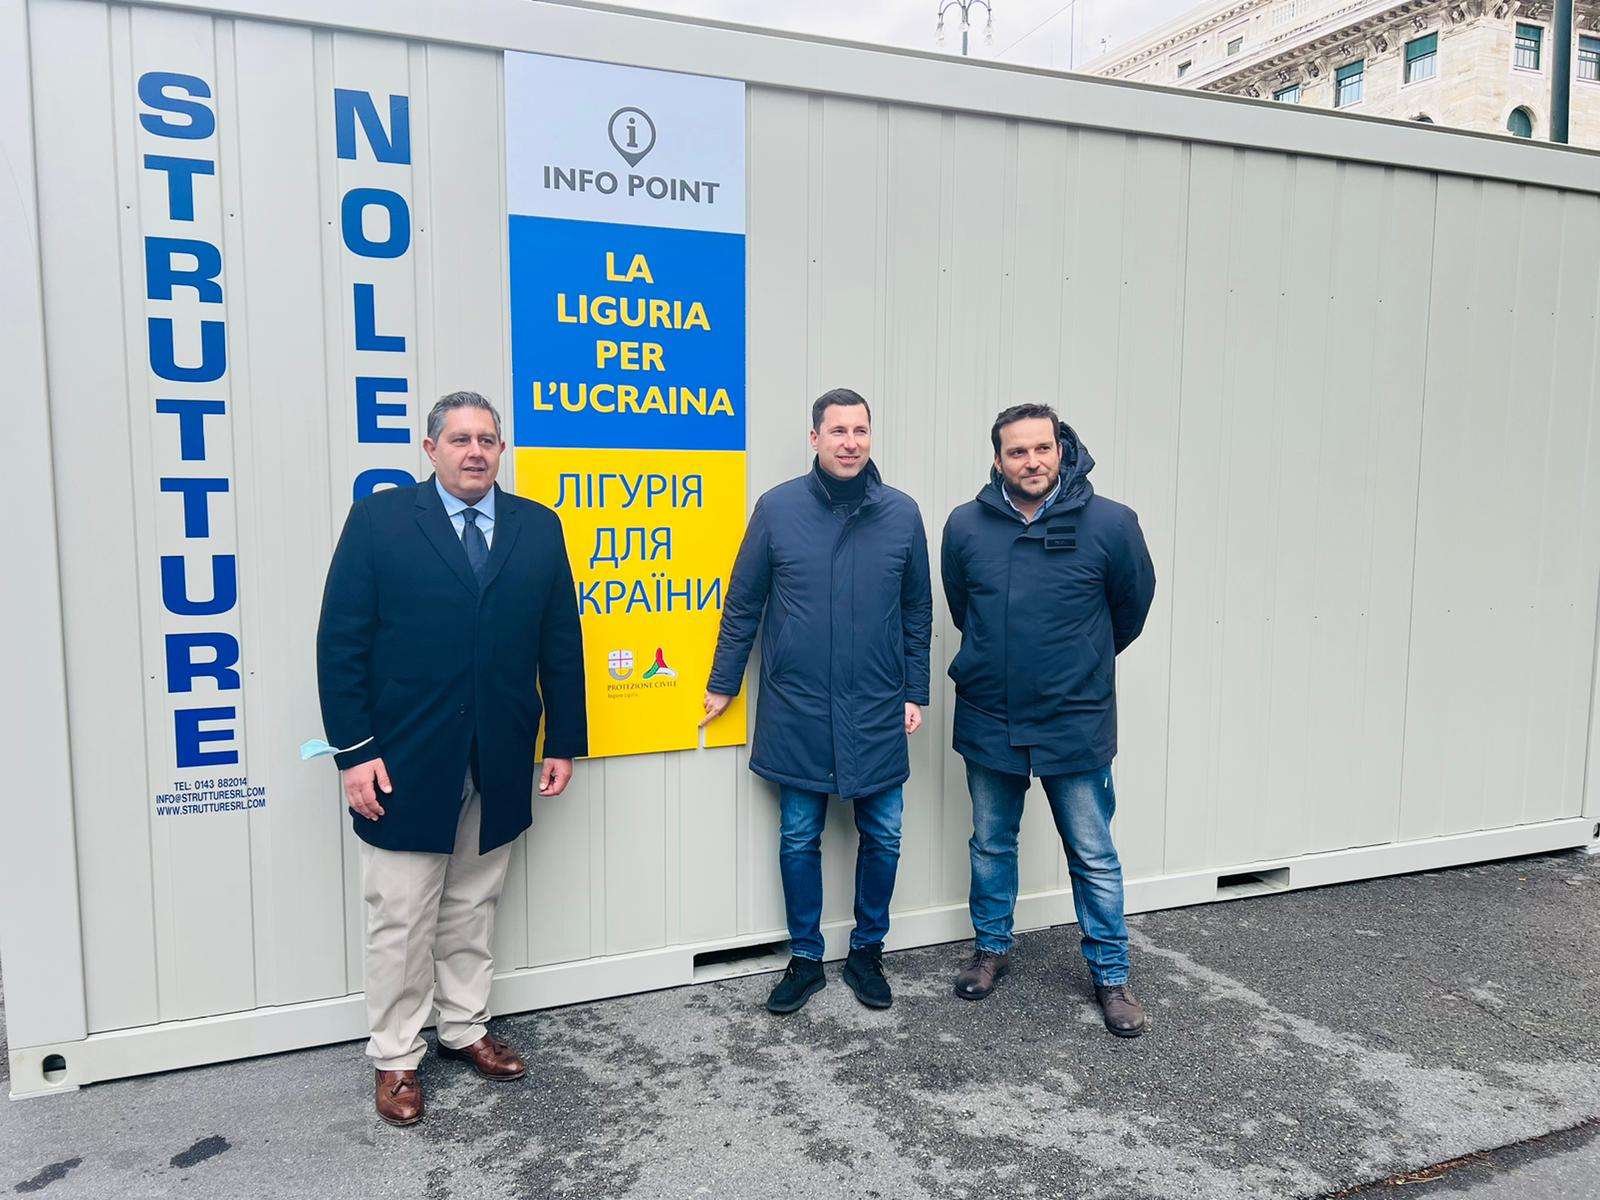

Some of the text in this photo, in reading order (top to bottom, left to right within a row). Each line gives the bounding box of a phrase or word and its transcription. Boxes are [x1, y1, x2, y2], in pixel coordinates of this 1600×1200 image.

[543, 165, 720, 204] INFO POINT
[605, 251, 654, 284] LA
[557, 293, 711, 331] LIGURIA
[596, 340, 666, 372] PER
[532, 381, 735, 417] L’UCRAINA
[137, 71, 241, 768] STRUTTURE
[554, 473, 703, 509] ЛІГУРІЯ
[590, 527, 671, 569] ДЛЯ
[578, 573, 721, 616] КРАЇНИ
[156, 786, 265, 804] INFO@STRUTTURESRL.COM
[194, 779, 215, 790] 0143
[156, 798, 266, 816] WWW.STRUTTURESRL.COM
